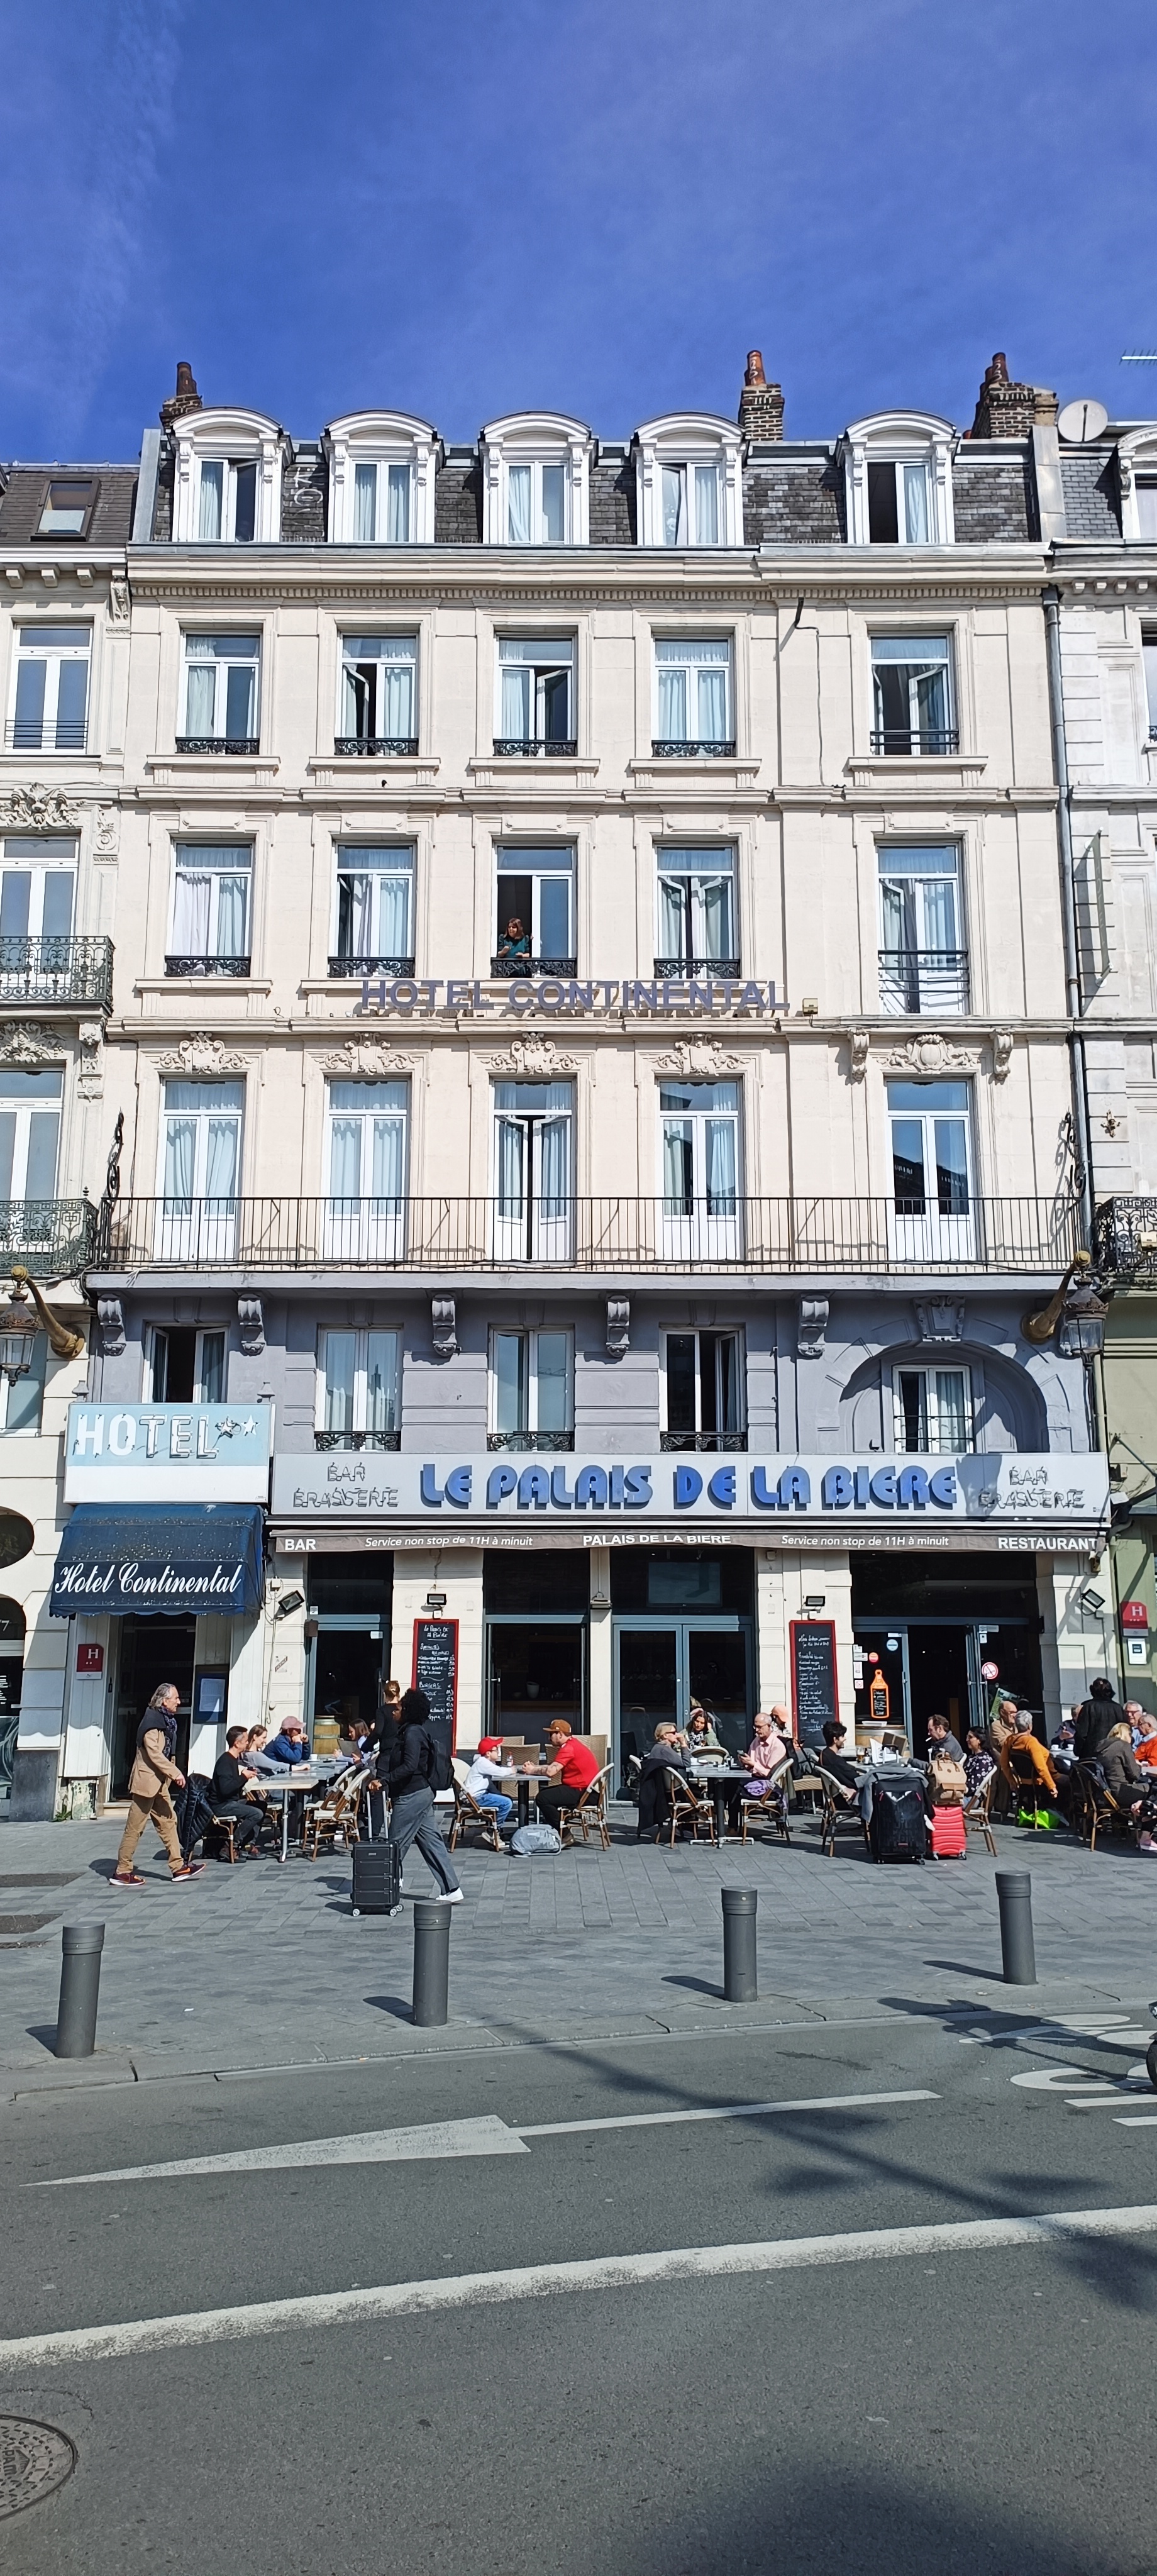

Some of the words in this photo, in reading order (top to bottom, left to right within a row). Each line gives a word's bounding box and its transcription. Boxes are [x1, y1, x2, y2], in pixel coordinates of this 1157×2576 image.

[362, 980, 495, 1010] HOTEL
[509, 980, 790, 1010] CONTINENTAL
[75, 1414, 219, 1459] HOTEL
[328, 1462, 365, 1482] BAR
[1009, 1467, 1048, 1485] BAR
[420, 1464, 472, 1509] LE
[486, 1465, 653, 1509] PALAIS
[673, 1465, 736, 1509] DE
[751, 1466, 811, 1510] LA
[821, 1466, 956, 1510] BIERE
[293, 1487, 399, 1508] BRASSERIE
[978, 1488, 1085, 1509] BRASSERIE
[285, 1538, 316, 1550] BAR
[365, 1537, 402, 1547] Service
[426, 1536, 450, 1547] stop
[452, 1536, 466, 1544] de
[469, 1536, 489, 1545] 11H
[492, 1536, 499, 1545] à
[501, 1536, 533, 1546] minuit
[583, 1535, 635, 1546] PALAIS
[639, 1535, 659, 1543] DE
[687, 1535, 731, 1543] BIERE
[782, 1535, 818, 1545] Service
[843, 1537, 865, 1548] stop
[868, 1536, 882, 1546] de
[885, 1536, 905, 1546] 11H
[908, 1536, 914, 1545] à
[917, 1536, 949, 1546] minuit
[998, 1537, 1098, 1550] RESTAURANT
[55, 1563, 116, 1593] Hotel
[118, 1563, 242, 1593] Continental
[1132, 1606, 1143, 1616] H
[0, 1619, 9, 1631] 7
[87, 1648, 99, 1659] H
